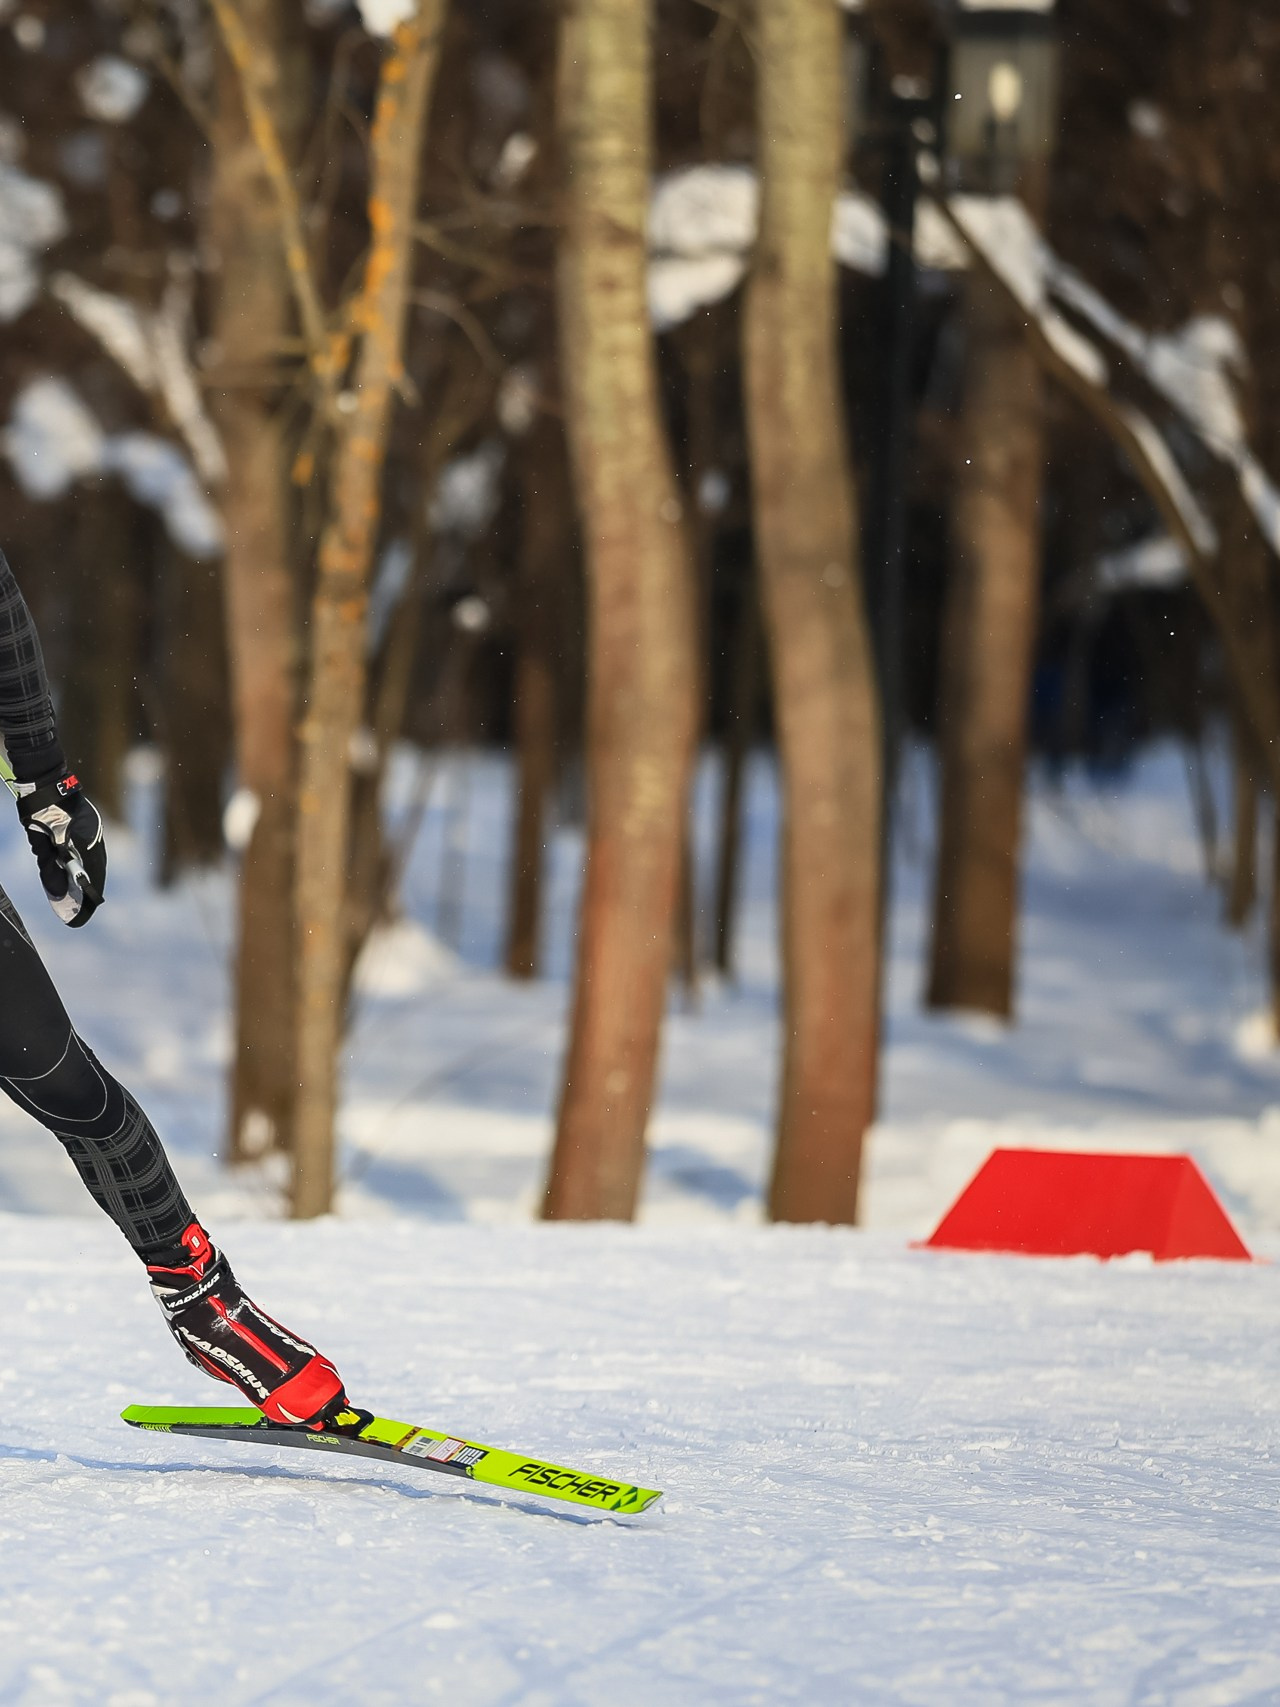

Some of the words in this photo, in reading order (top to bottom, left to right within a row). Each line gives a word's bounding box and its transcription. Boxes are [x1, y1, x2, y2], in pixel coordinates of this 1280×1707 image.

[178, 1326, 271, 1400] MADSHUS
[306, 1433, 342, 1446] FISCHER
[508, 1463, 621, 1502] FISCHER
